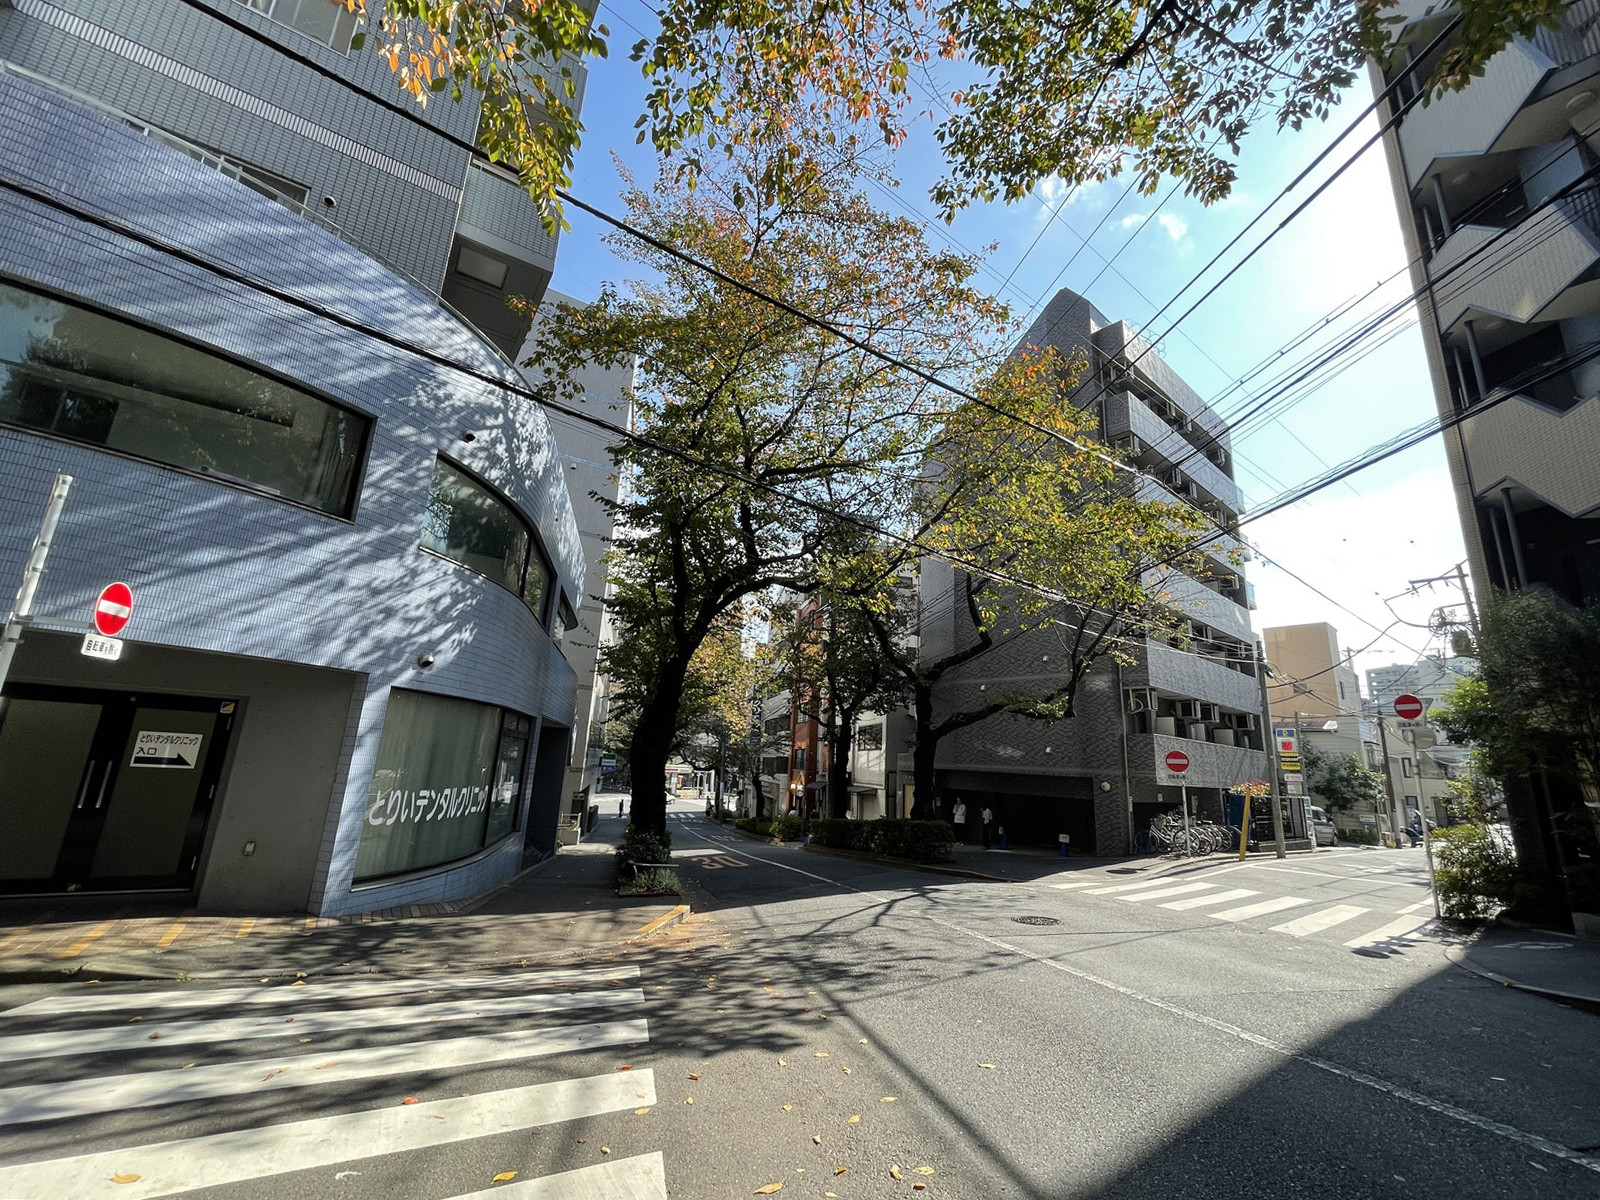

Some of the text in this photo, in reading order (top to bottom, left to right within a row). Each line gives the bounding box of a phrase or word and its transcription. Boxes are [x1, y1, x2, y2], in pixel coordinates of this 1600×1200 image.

[140, 734, 199, 746] とりいデンタルクリニック
[136, 746, 157, 755] 入口
[369, 785, 489, 826] とりいデンタルクリニック
[691, 855, 749, 870] 30
